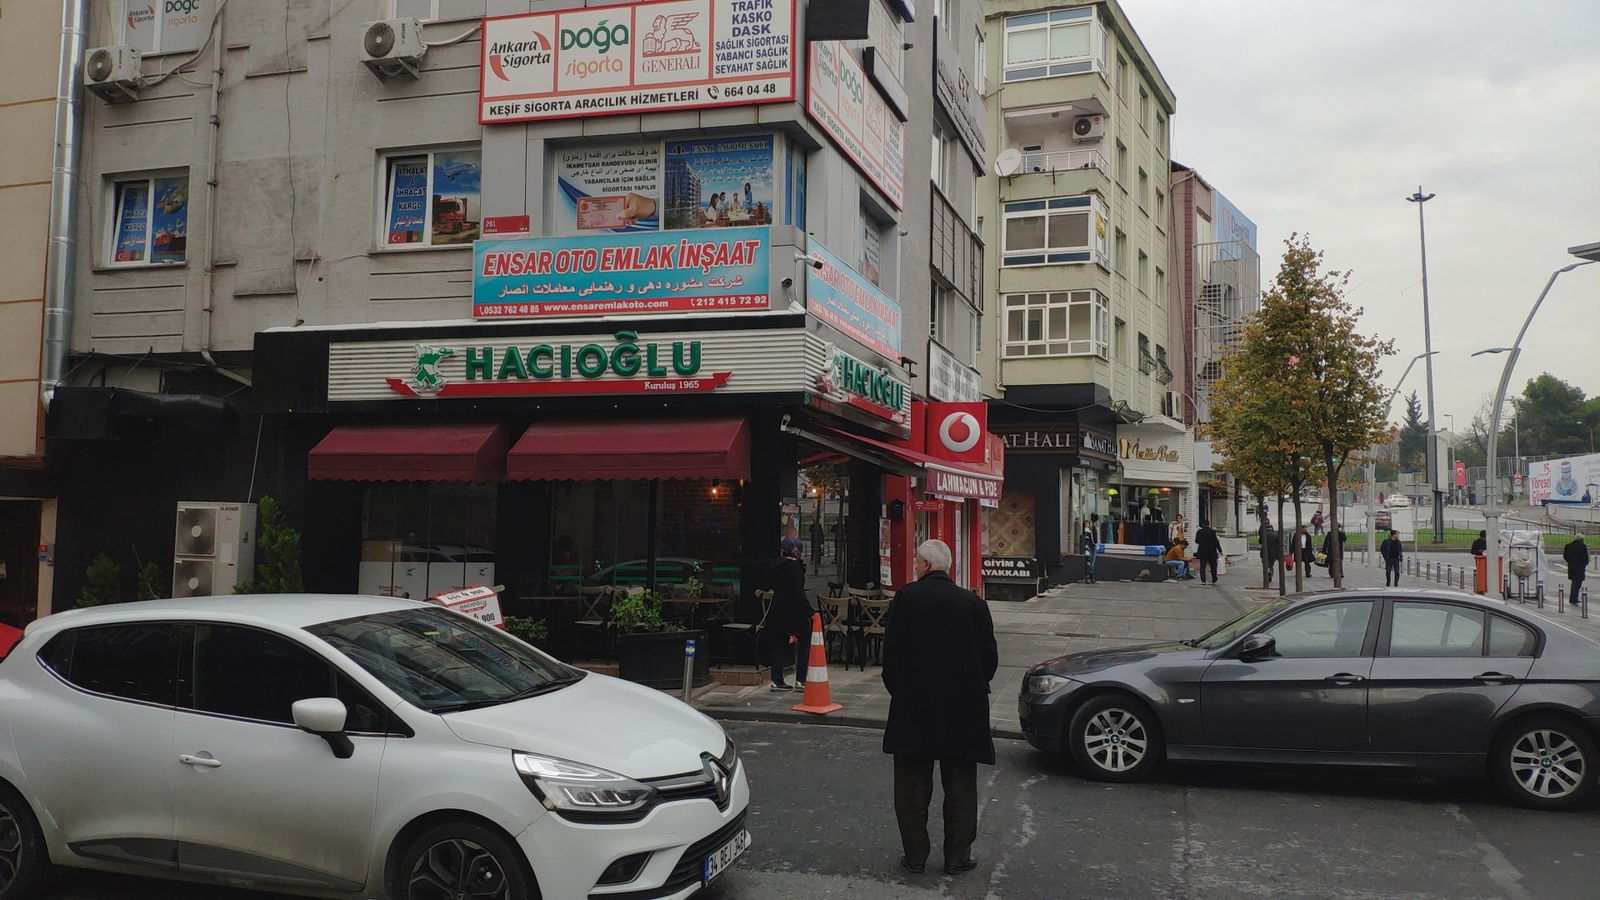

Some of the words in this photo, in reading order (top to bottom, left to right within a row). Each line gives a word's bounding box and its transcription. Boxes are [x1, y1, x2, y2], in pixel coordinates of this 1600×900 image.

[732, 11, 772, 25] KASKO
[561, 20, 628, 54] Doğa
[732, 24, 771, 38] DASK
[490, 40, 537, 54] Ankara
[716, 38, 744, 50] SAĞLIK
[746, 34, 788, 48] SİGORTASI
[502, 53, 550, 68] Sigorta
[716, 50, 752, 62] YABANCI
[756, 46, 788, 59] SAĞLIK
[565, 56, 622, 79] sigorta
[642, 56, 700, 74] GENERALI
[716, 62, 754, 74] SEYAHAT
[756, 58, 788, 70] SAĞLIK
[840, 60, 862, 104] Doğa
[490, 103, 520, 118] KEŞİF
[524, 100, 572, 112] SİGORTA
[575, 96, 626, 109] ARACILIK
[630, 89, 698, 104] HİZMETLERİ
[724, 86, 744, 97] 664
[747, 85, 760, 96] 04
[763, 83, 776, 94] 48
[397, 201, 422, 211] KARGO
[483, 251, 552, 276] ENSAR
[555, 248, 598, 274] OTO
[600, 245, 676, 272] EMLAK
[678, 238, 760, 275] İNŞAAT
[533, 283, 575, 294] معاملات
[579, 281, 623, 296] رهنمایی
[638, 280, 662, 294] دهی
[666, 278, 704, 291] مشوره
[707, 275, 742, 289] شرکت
[498, 284, 528, 298] انصار
[484, 306, 502, 314] 0532
[504, 305, 516, 314] 762
[544, 300, 668, 312] www.ensaremlakoto.com
[696, 298, 714, 306] 212
[718, 298, 736, 306] 415
[466, 331, 702, 380] HACIOĞLU
[644, 381, 676, 390] Kuruluş
[679, 380, 700, 388] 1965
[1002, 434, 1020, 448] AT
[1025, 432, 1071, 448] HALI
[937, 472, 978, 494] LAHMACUN
[984, 559, 1014, 568] GİYİM
[482, 612, 496, 622] 900
[710, 856, 718, 876] 34
